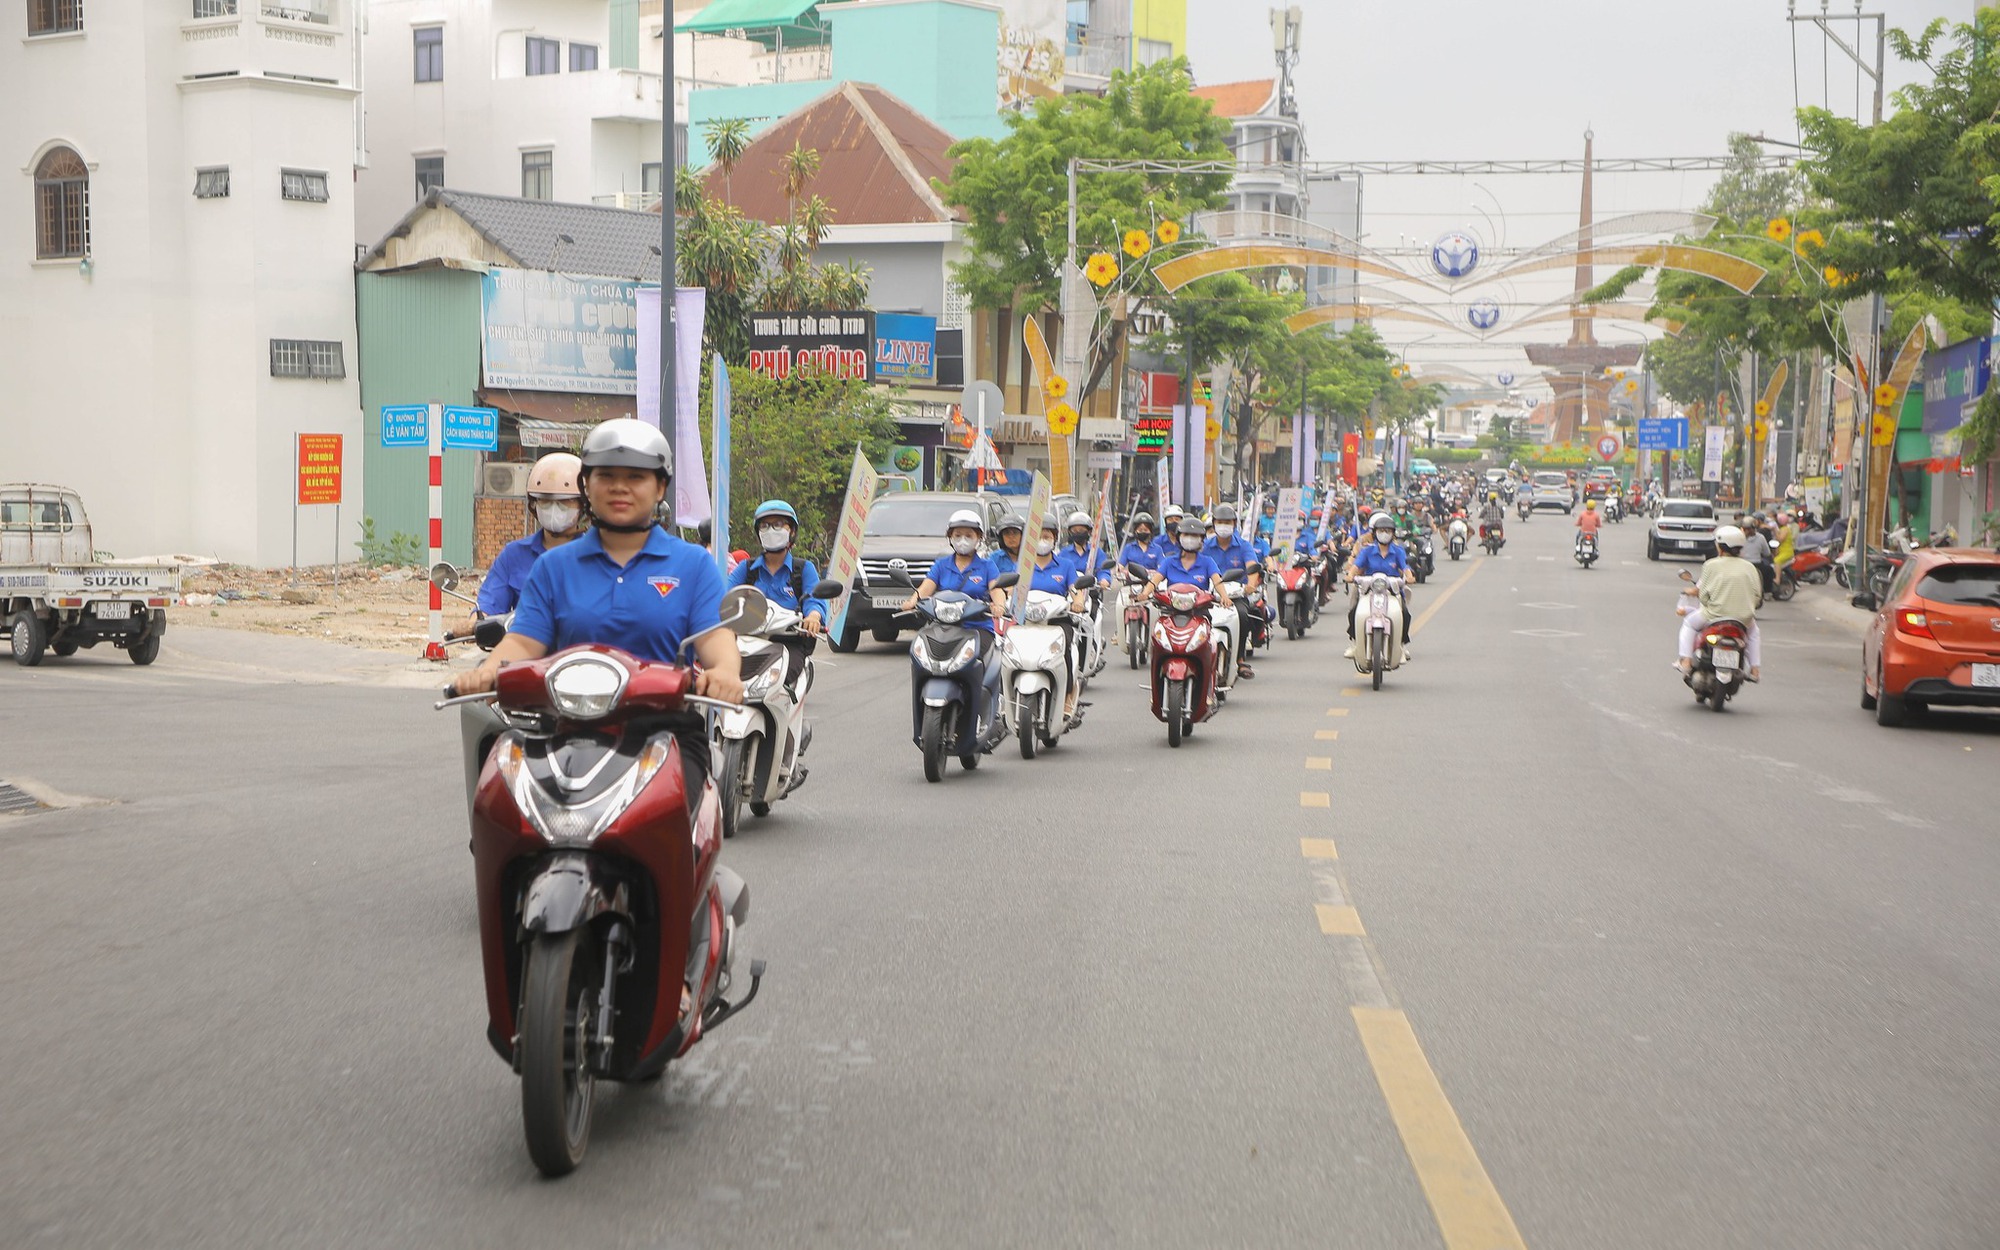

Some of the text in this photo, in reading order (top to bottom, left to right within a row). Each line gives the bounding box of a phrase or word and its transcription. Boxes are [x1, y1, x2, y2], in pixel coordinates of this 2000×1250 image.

[494, 276, 533, 291] TRUNG
[591, 284, 622, 299] CHỮA
[754, 319, 779, 336] TRUNG
[781, 316, 799, 336] TÂM
[800, 315, 817, 336] SỬA
[819, 315, 841, 336] CHỮA
[488, 325, 523, 340] CHUYÊN
[529, 326, 548, 342] SỬA
[550, 329, 574, 344] CHỮA
[876, 339, 931, 366] LINH
[750, 344, 867, 381] PHÚ CƯỜNG
[504, 376, 525, 388] Nguyễn
[602, 382, 619, 392] Dương
[396, 412, 415, 422] ĐƯỜNG
[459, 415, 481, 425] ĐƯỜNG
[386, 423, 425, 438] LÊ VĂN TÁM
[446, 426, 494, 440] CÁCH MẠNG THÁNG TÁM
[541, 432, 565, 444] TRUNG
[83, 576, 149, 587] SUZUKI
[106, 603, 122, 611] 51D
[101, 610, 127, 619] 749.07
